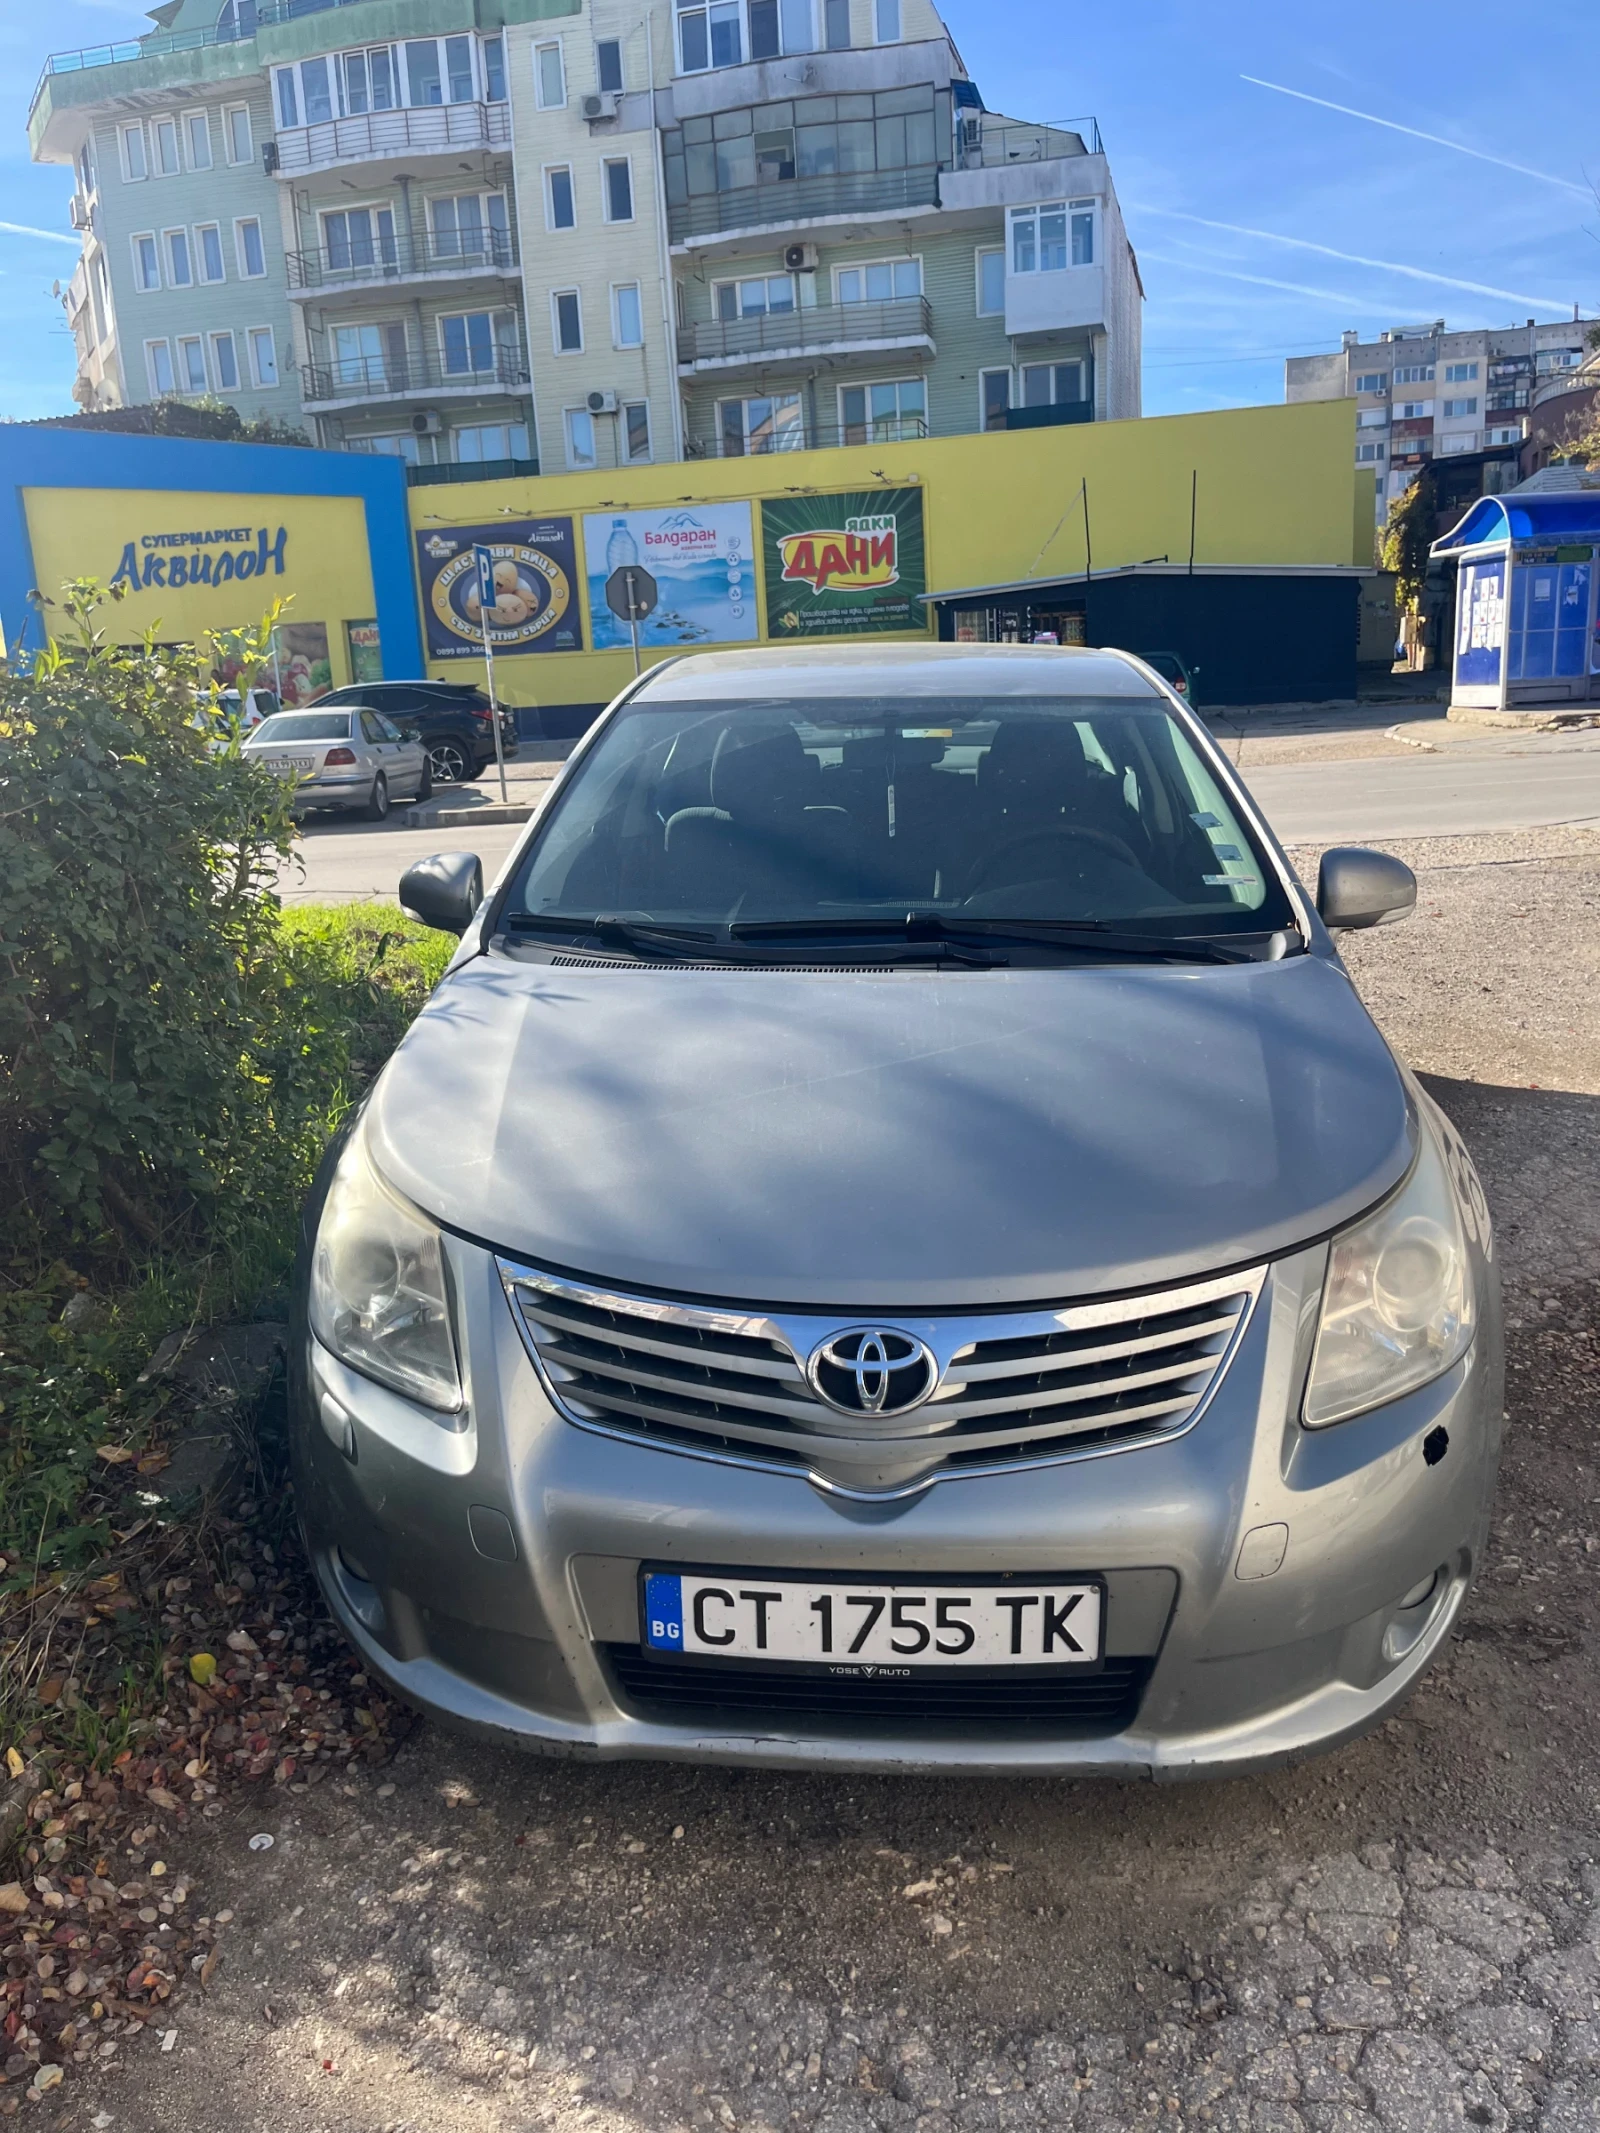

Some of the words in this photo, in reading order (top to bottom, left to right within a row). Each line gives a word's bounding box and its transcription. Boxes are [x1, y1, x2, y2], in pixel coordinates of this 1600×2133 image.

[847, 516, 894, 532] ЯДКИ
[141, 527, 252, 549] СУПЕРМАРКЕТ
[644, 529, 716, 546] Балдаран
[520, 549, 558, 578] ЯЙЦА
[783, 531, 895, 591] ДАНИ
[479, 553, 490, 600] P
[451, 616, 472, 635] СЪС
[475, 628, 519, 641] ЗАТНИ
[522, 608, 556, 636] СЪРЦА
[456, 646, 470, 654] 899
[652, 1620, 680, 1639] BG
[693, 1587, 782, 1649] CT
[810, 1594, 974, 1655] 1755
[995, 1594, 1085, 1654] TK
[829, 1666, 859, 1674] YOSE
[879, 1668, 910, 1676] AUTO
